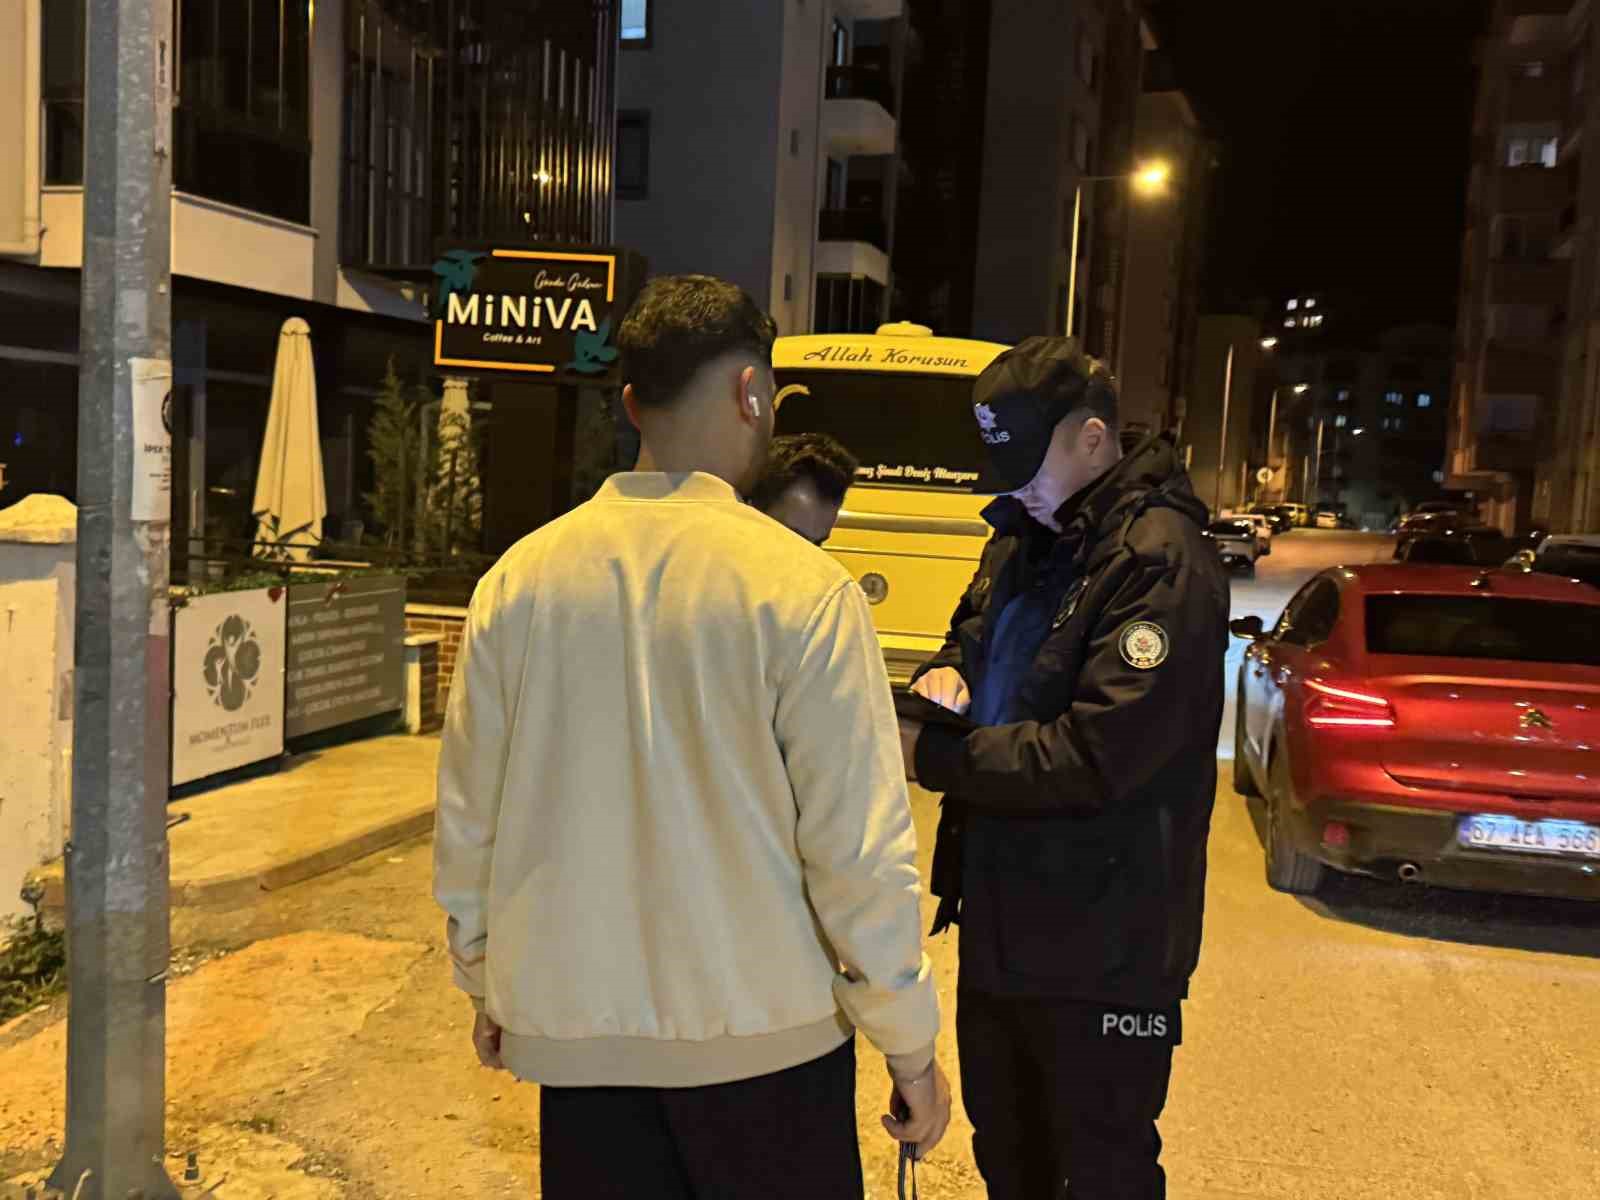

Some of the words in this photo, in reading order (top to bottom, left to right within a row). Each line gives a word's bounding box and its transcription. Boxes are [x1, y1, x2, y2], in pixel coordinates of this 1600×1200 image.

[483, 332, 513, 344] Coffee
[515, 333, 524, 344] &
[525, 334, 542, 345] Art
[803, 346, 873, 363] Allah
[880, 347, 969, 368] Korusun
